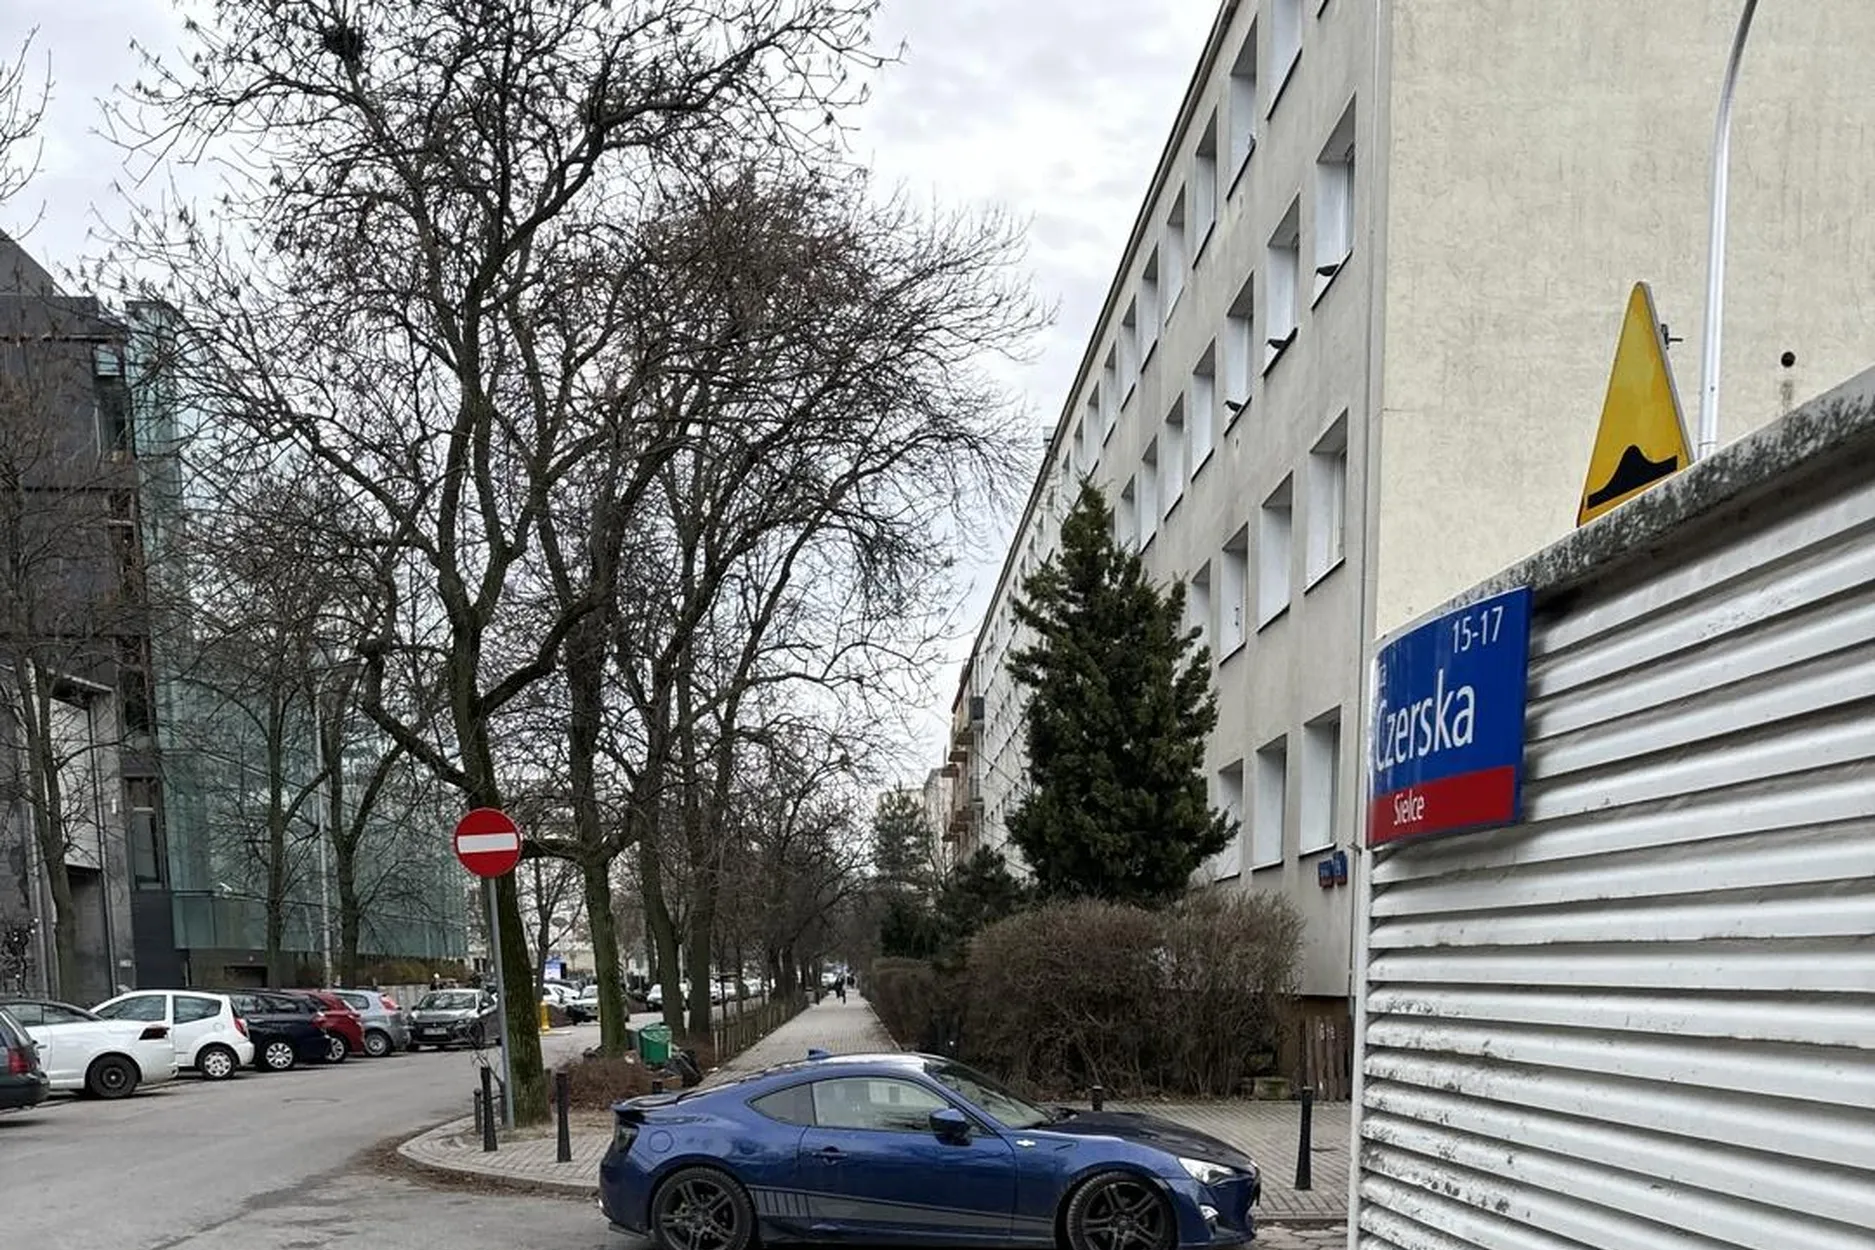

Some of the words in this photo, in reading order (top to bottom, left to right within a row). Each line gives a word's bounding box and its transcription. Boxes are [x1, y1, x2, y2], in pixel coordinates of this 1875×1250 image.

[1453, 606, 1503, 653] 15-17
[1376, 669, 1475, 771] Czerska
[1394, 789, 1424, 825] Sielce
